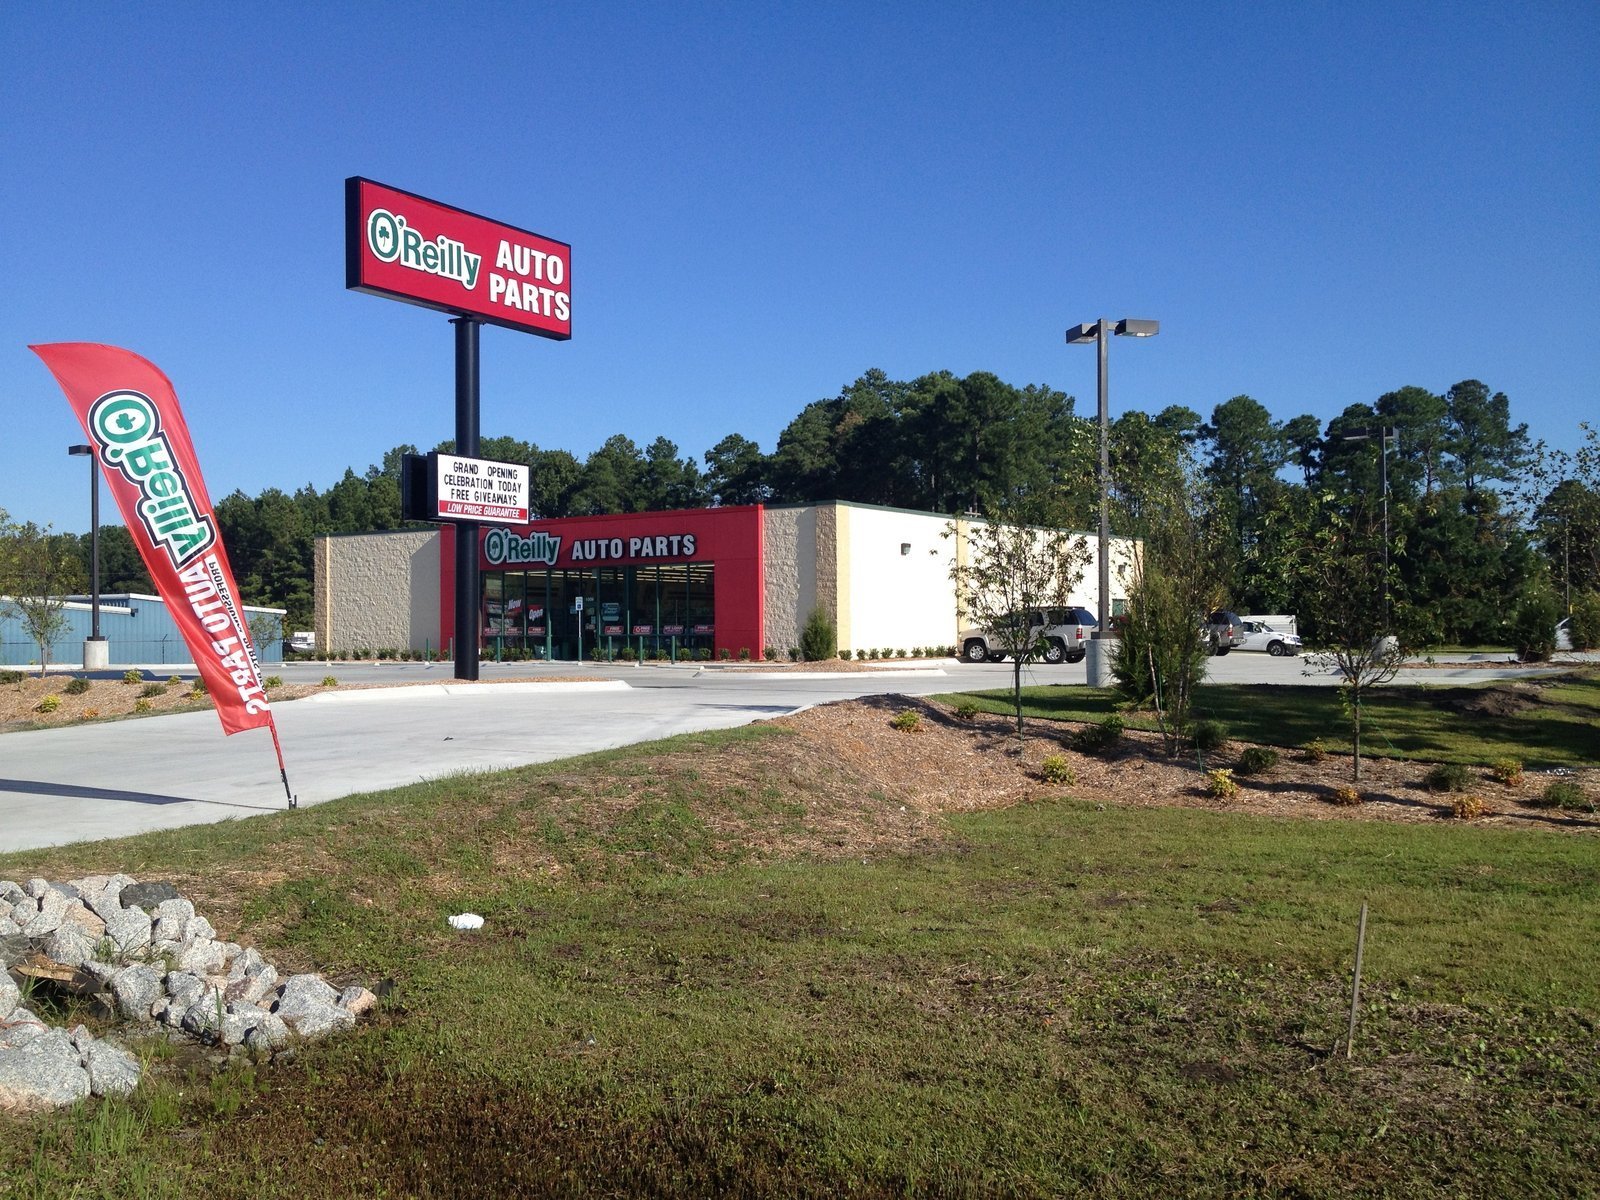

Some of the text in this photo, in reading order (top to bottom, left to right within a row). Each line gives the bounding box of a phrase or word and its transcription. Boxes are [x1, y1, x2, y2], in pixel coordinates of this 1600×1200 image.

[367, 208, 481, 290] O'Reilly
[496, 240, 563, 285] AUTO
[489, 272, 570, 321] PARTS
[443, 474, 522, 493] CELEBRATION TODAY
[453, 461, 518, 480] GRAND OPENING
[447, 502, 520, 518] LOW PRICE GUARANTEE
[450, 488, 517, 506] FREE GIVEAWAYS
[485, 527, 696, 566] O'Reilly AUTO PARTS
